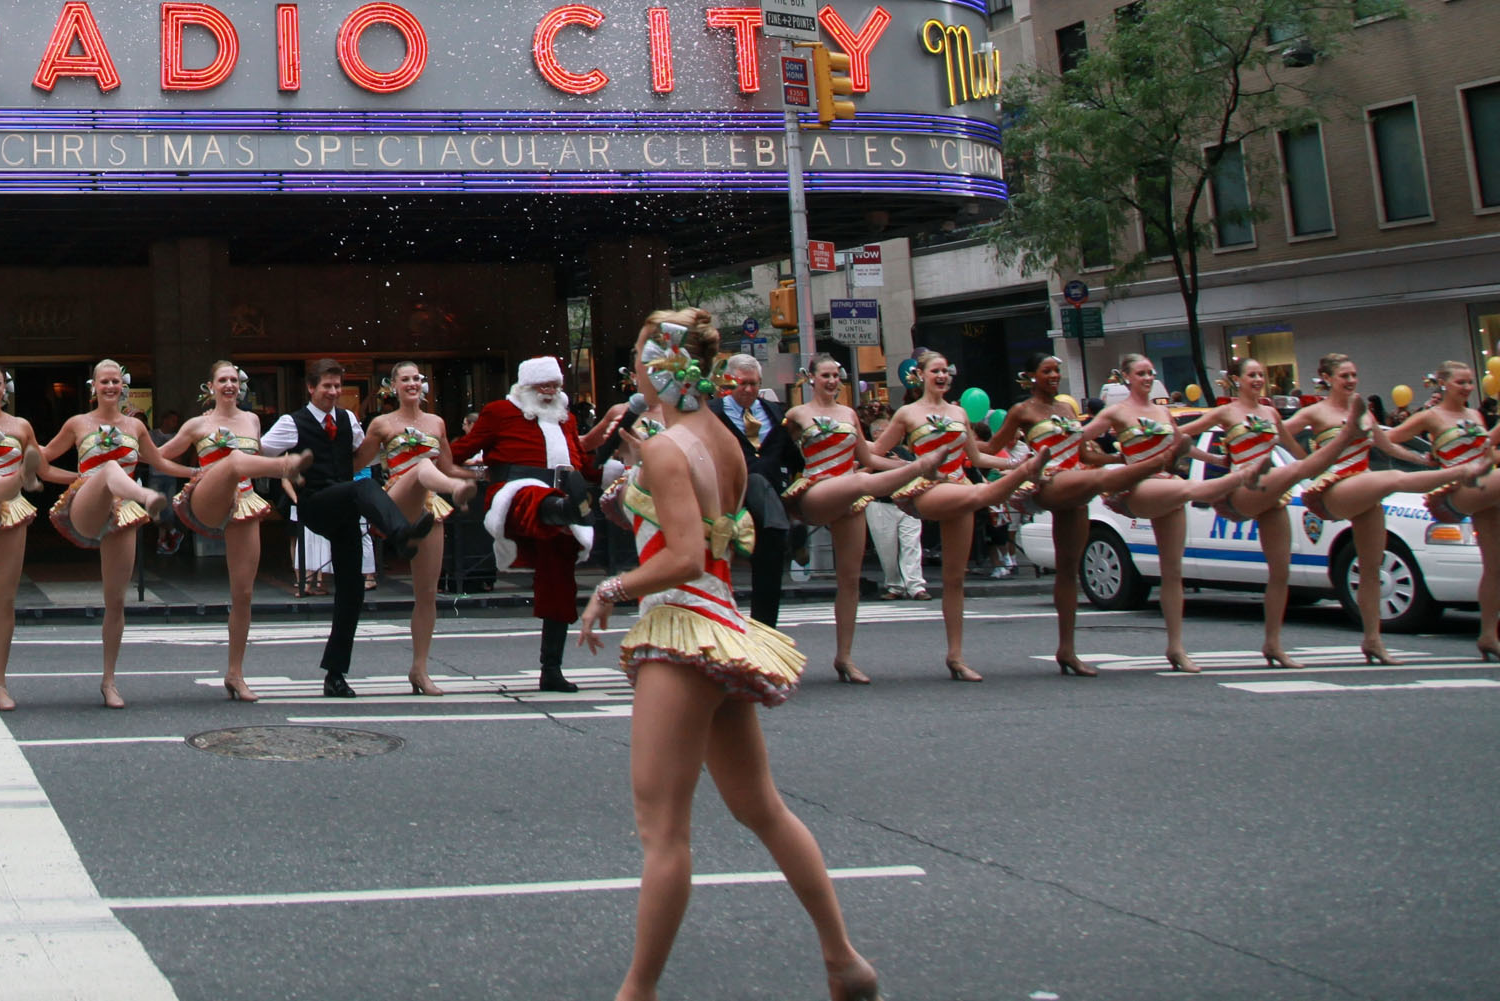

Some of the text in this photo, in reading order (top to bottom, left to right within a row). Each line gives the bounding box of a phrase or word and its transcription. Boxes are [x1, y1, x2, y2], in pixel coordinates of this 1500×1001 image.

[767, 13, 781, 25] FINE
[792, 16, 814, 29] POINTS
[532, 2, 892, 96] CITY
[785, 61, 804, 71] DON'T
[786, 71, 805, 81] HONK
[0, 133, 254, 167] CHRISTMAS
[293, 134, 610, 168] SPECTACULAR
[643, 135, 907, 169] CELEBATES
[1388, 505, 1432, 521] POLICE
